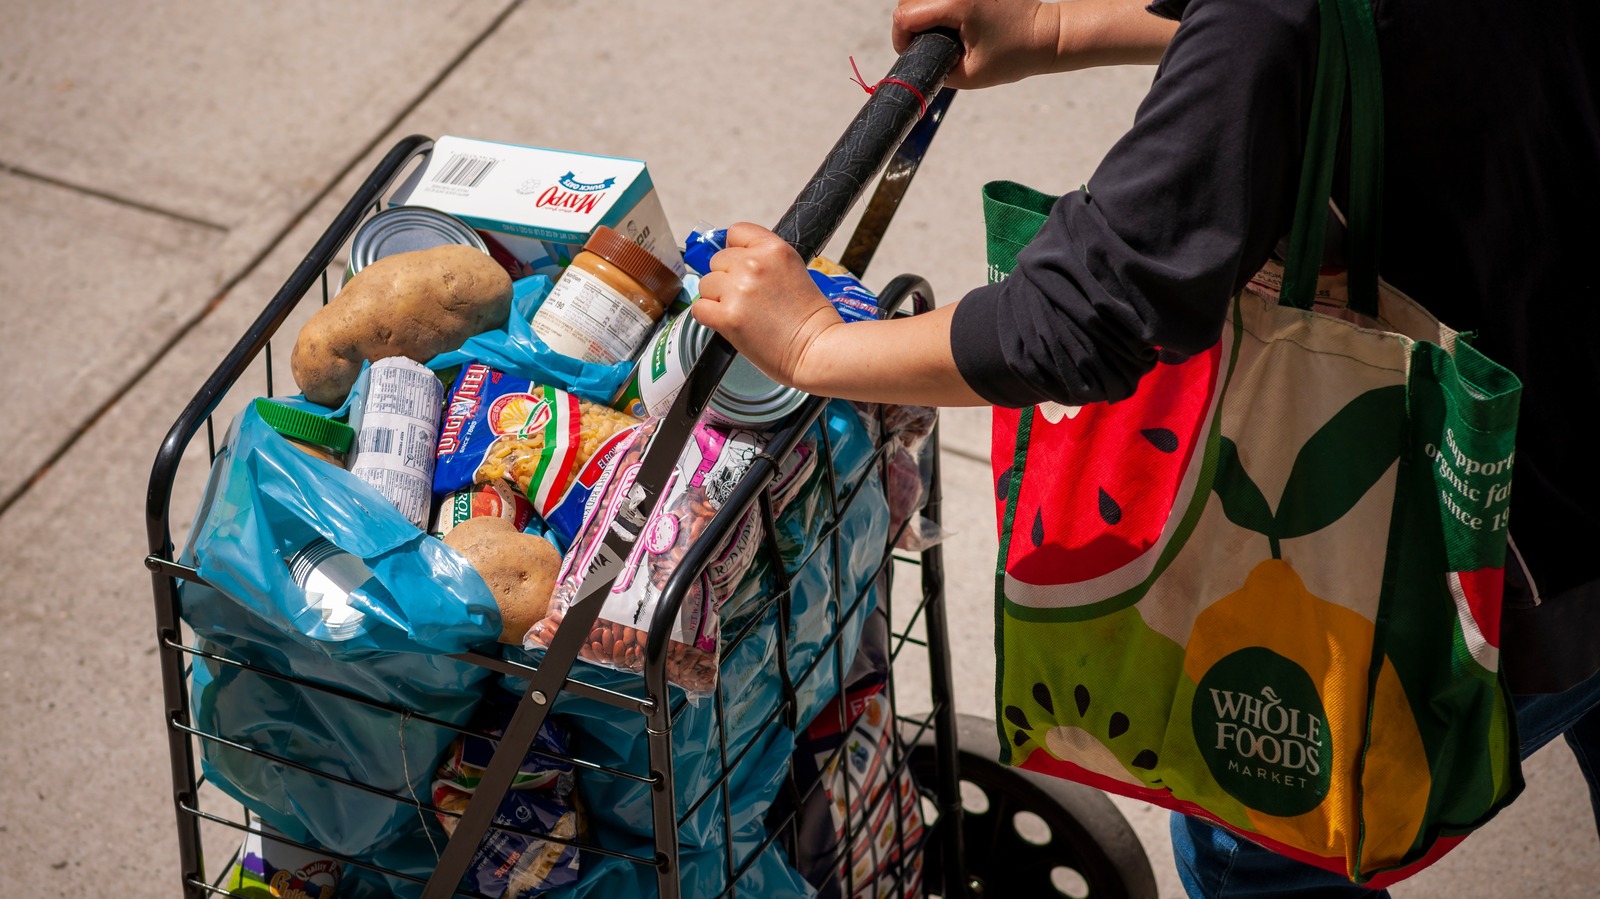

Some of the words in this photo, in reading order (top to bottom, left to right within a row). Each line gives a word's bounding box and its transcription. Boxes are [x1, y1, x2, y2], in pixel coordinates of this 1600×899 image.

[564, 179, 580, 190] OATS
[582, 183, 605, 192] QUICK
[536, 186, 605, 214] MAYPO
[554, 300, 565, 310] 190
[438, 411, 464, 455] LUIGI
[459, 436, 470, 453] SINCE
[1425, 443, 1481, 502] organic
[1442, 490, 1482, 530] since
[587, 553, 612, 575] MIA
[689, 617, 698, 631] NET
[1209, 686, 1322, 746] WHOLE
[1215, 722, 1320, 776] FOODS
[1228, 760, 1308, 788] MARKET
[295, 863, 326, 881] Quality
